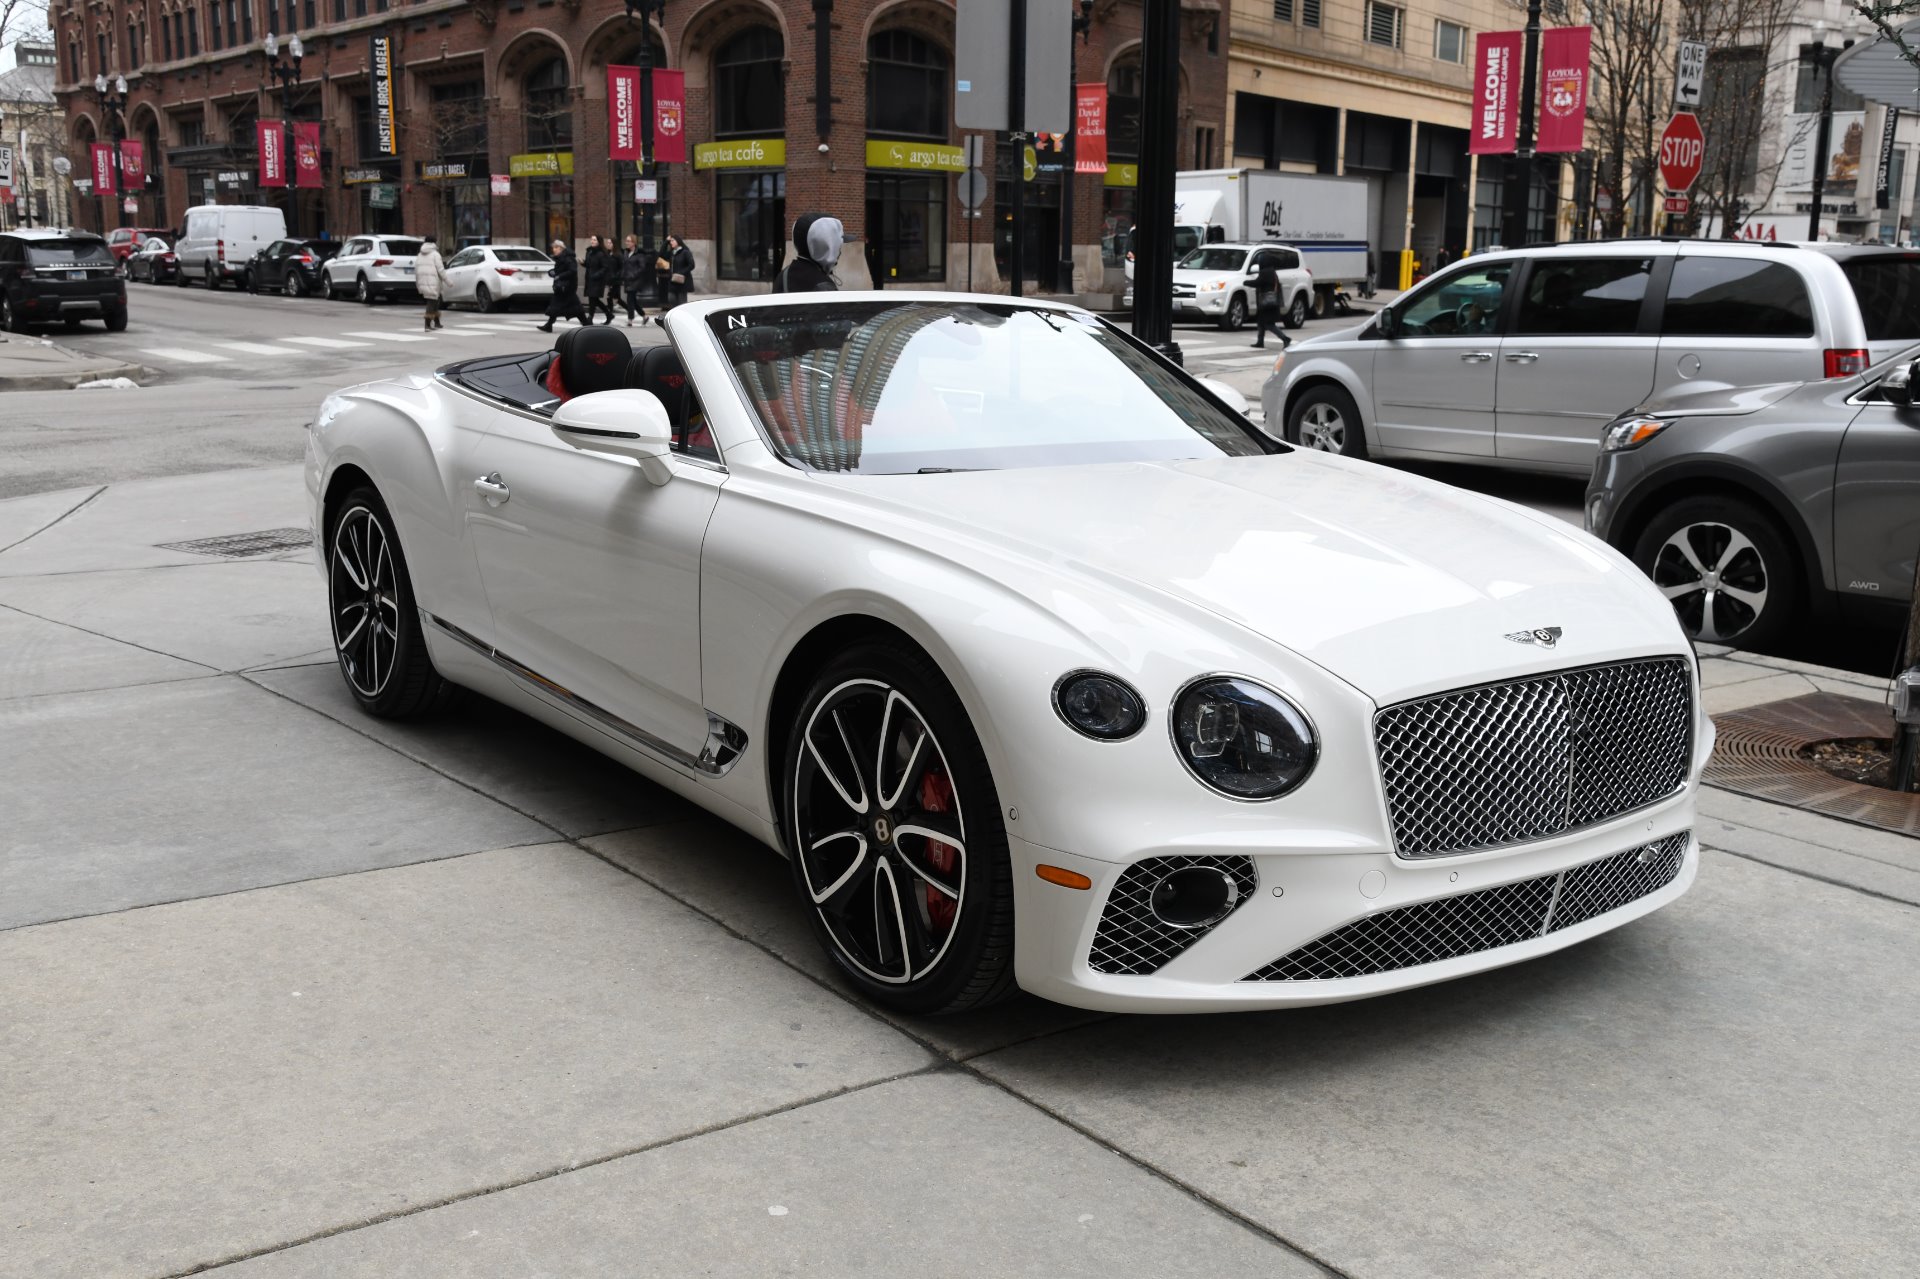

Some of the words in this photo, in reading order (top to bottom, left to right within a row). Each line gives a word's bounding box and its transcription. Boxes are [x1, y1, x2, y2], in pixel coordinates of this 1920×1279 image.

[375, 38, 388, 77] BAGELS
[1500, 46, 1509, 82] CAMPUS
[1683, 46, 1703, 63] ONE
[1547, 68, 1582, 78] LOYOLA
[1681, 64, 1702, 80] WAY
[657, 99, 681, 107] LOYOLA
[1482, 46, 1501, 139] WELCOME
[1499, 82, 1507, 110] TOWER
[616, 77, 627, 148] WELCOME
[1078, 107, 1100, 117] David
[379, 107, 392, 153] EINSTEIN
[1497, 111, 1505, 139] WATER
[1882, 107, 1896, 163] ORDSTROM
[264, 128, 274, 179] WELCOME
[536, 154, 558, 171] café
[719, 148, 733, 161] tea
[735, 141, 765, 161] café
[910, 151, 935, 168] argo
[937, 151, 950, 165] tea
[1662, 136, 1701, 168] STOP
[96, 149, 107, 189] WELCOME
[448, 164, 465, 175] BAGELS
[1075, 161, 1108, 173] LUMA
[1262, 200, 1283, 227] Abt
[1665, 199, 1675, 210] ALL
[1676, 200, 1686, 210] WAY
[1849, 580, 1880, 591] AWD
